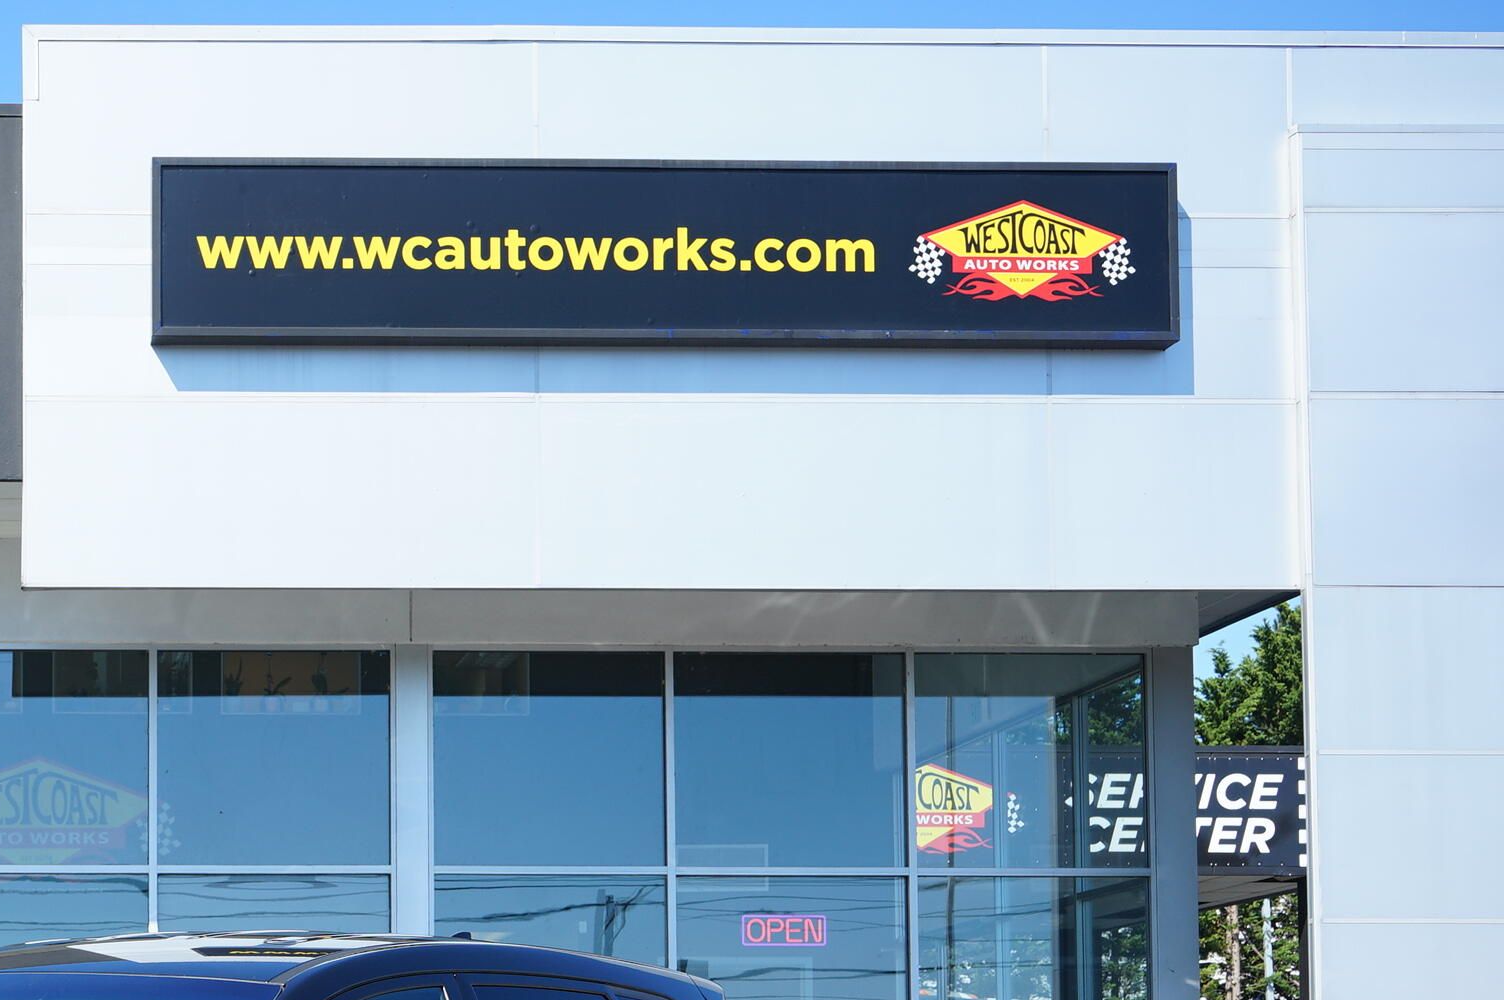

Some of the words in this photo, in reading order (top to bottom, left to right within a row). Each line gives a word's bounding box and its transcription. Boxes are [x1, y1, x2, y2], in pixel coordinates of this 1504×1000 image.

[196, 227, 876, 273] www.wcautoworks.com
[964, 259, 1012, 271] AUTO
[1016, 260, 1080, 271] WORKS
[916, 814, 974, 825] WORKS
[36, 831, 110, 846] WORKS
[746, 918, 823, 943] OPEN
